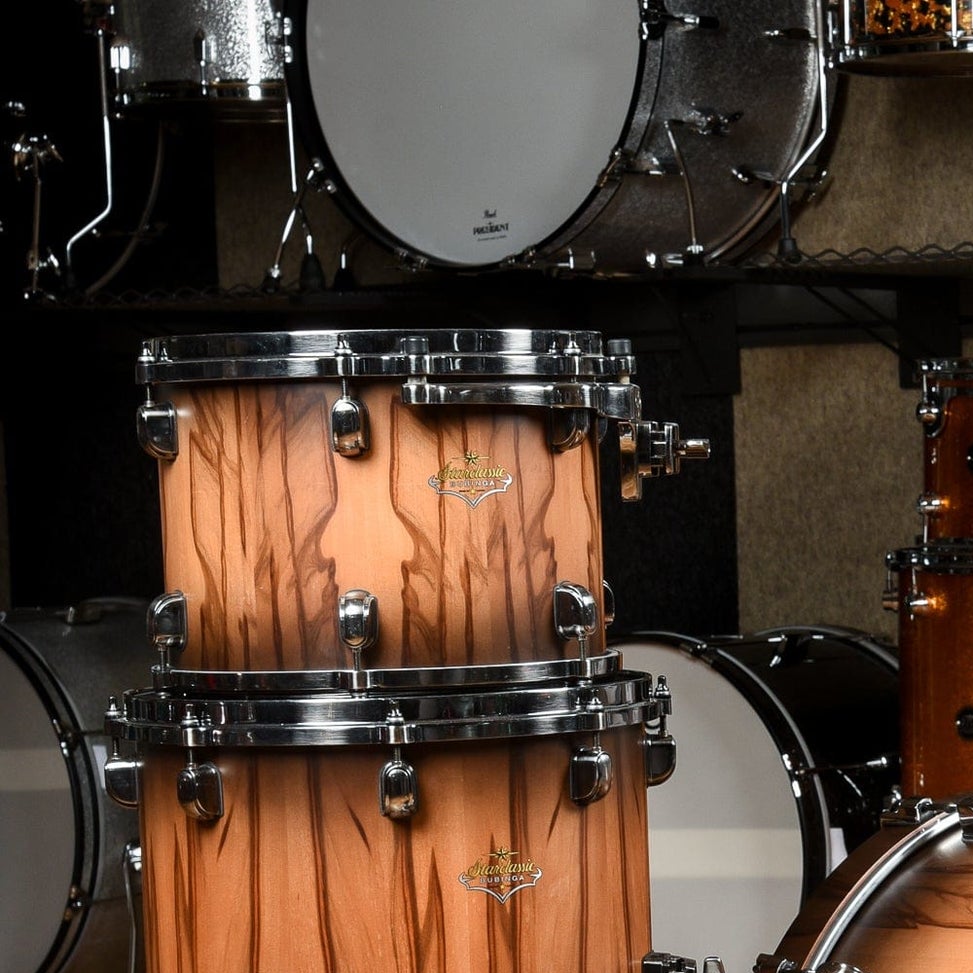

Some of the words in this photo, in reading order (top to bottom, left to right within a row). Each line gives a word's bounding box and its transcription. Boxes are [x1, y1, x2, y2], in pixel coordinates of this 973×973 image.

[438, 461, 507, 482] Starclassic
[468, 858, 536, 877] Starclassic
[480, 874, 525, 884] BUBINGA
